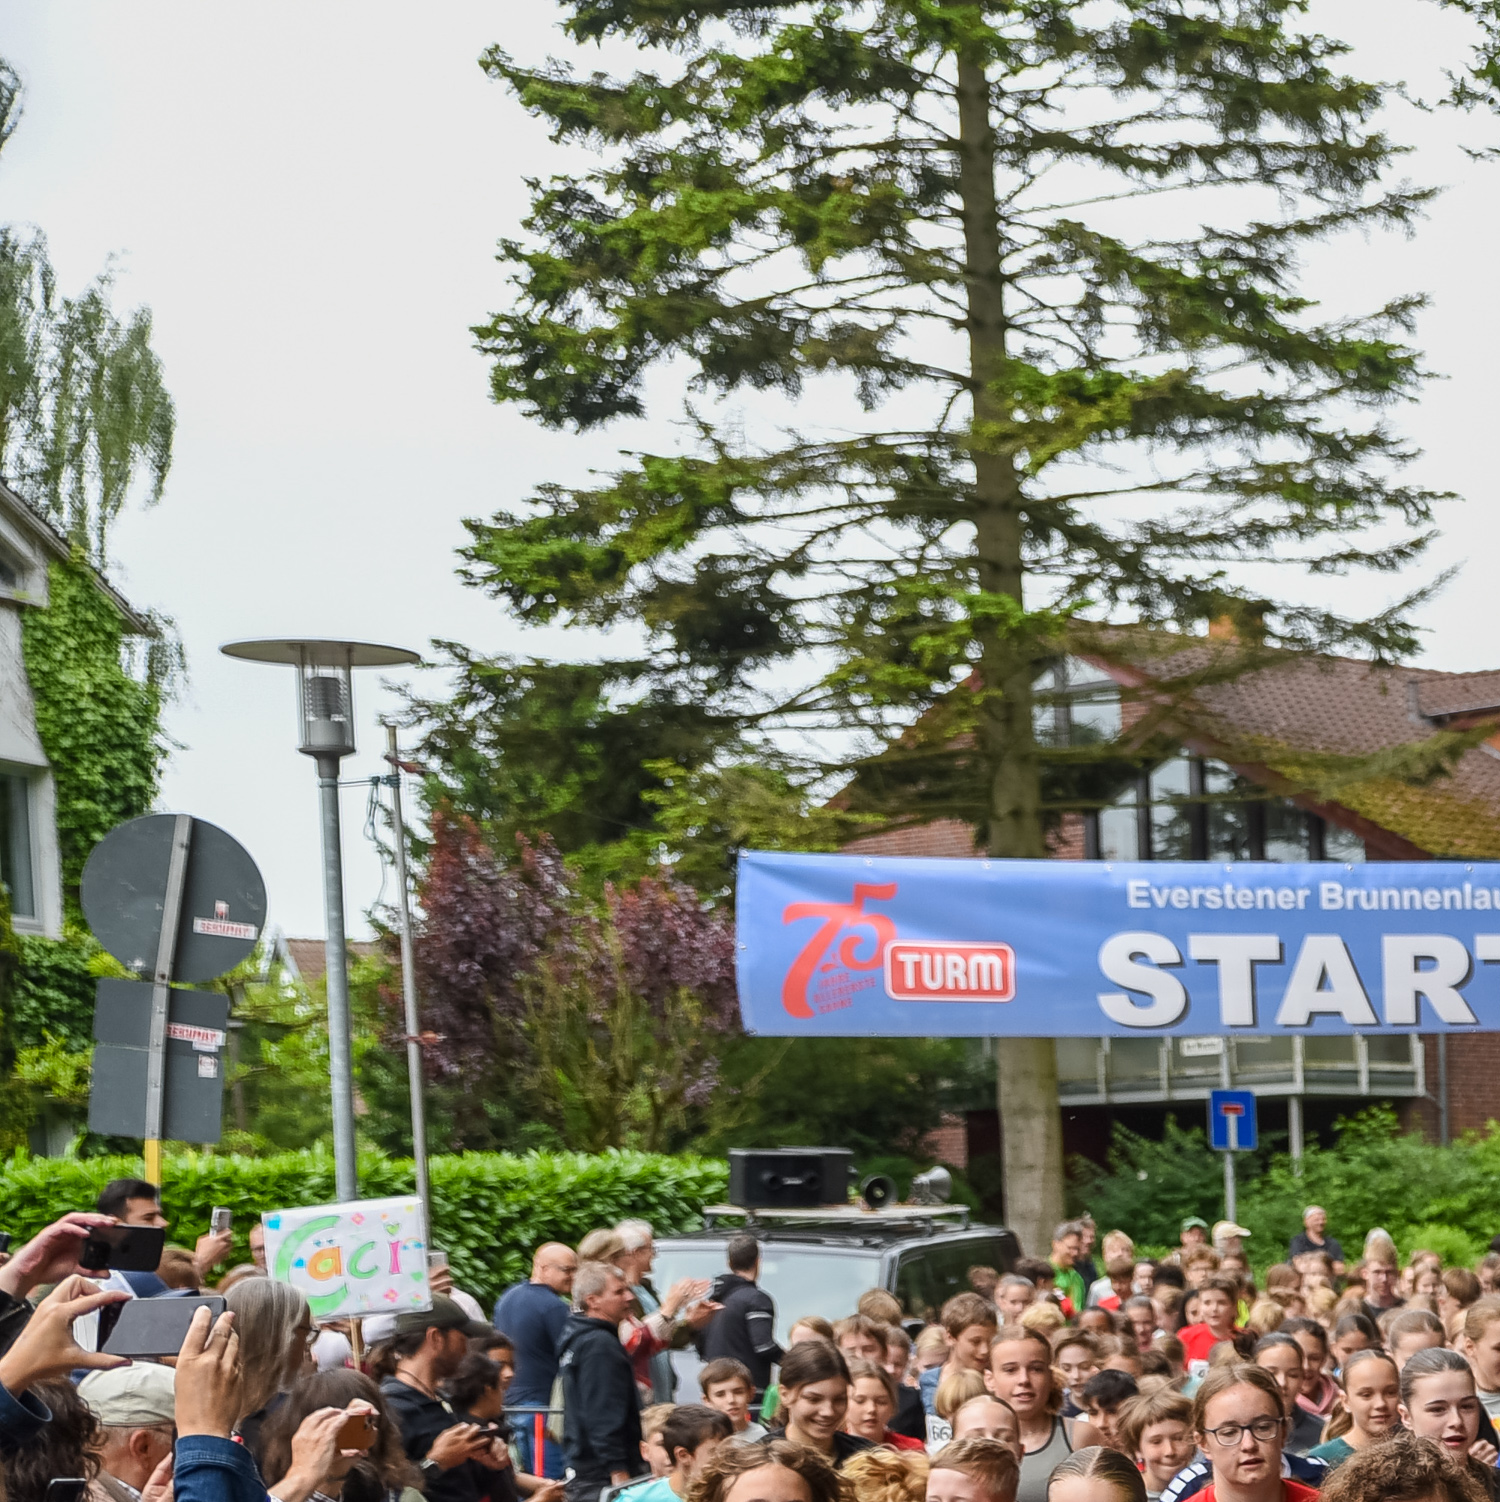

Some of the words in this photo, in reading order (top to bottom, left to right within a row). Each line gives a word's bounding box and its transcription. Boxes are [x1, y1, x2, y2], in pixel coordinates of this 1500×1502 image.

[1127, 880, 1310, 910] Everstener
[781, 882, 898, 1020] 75
[897, 952, 1004, 991] TURM
